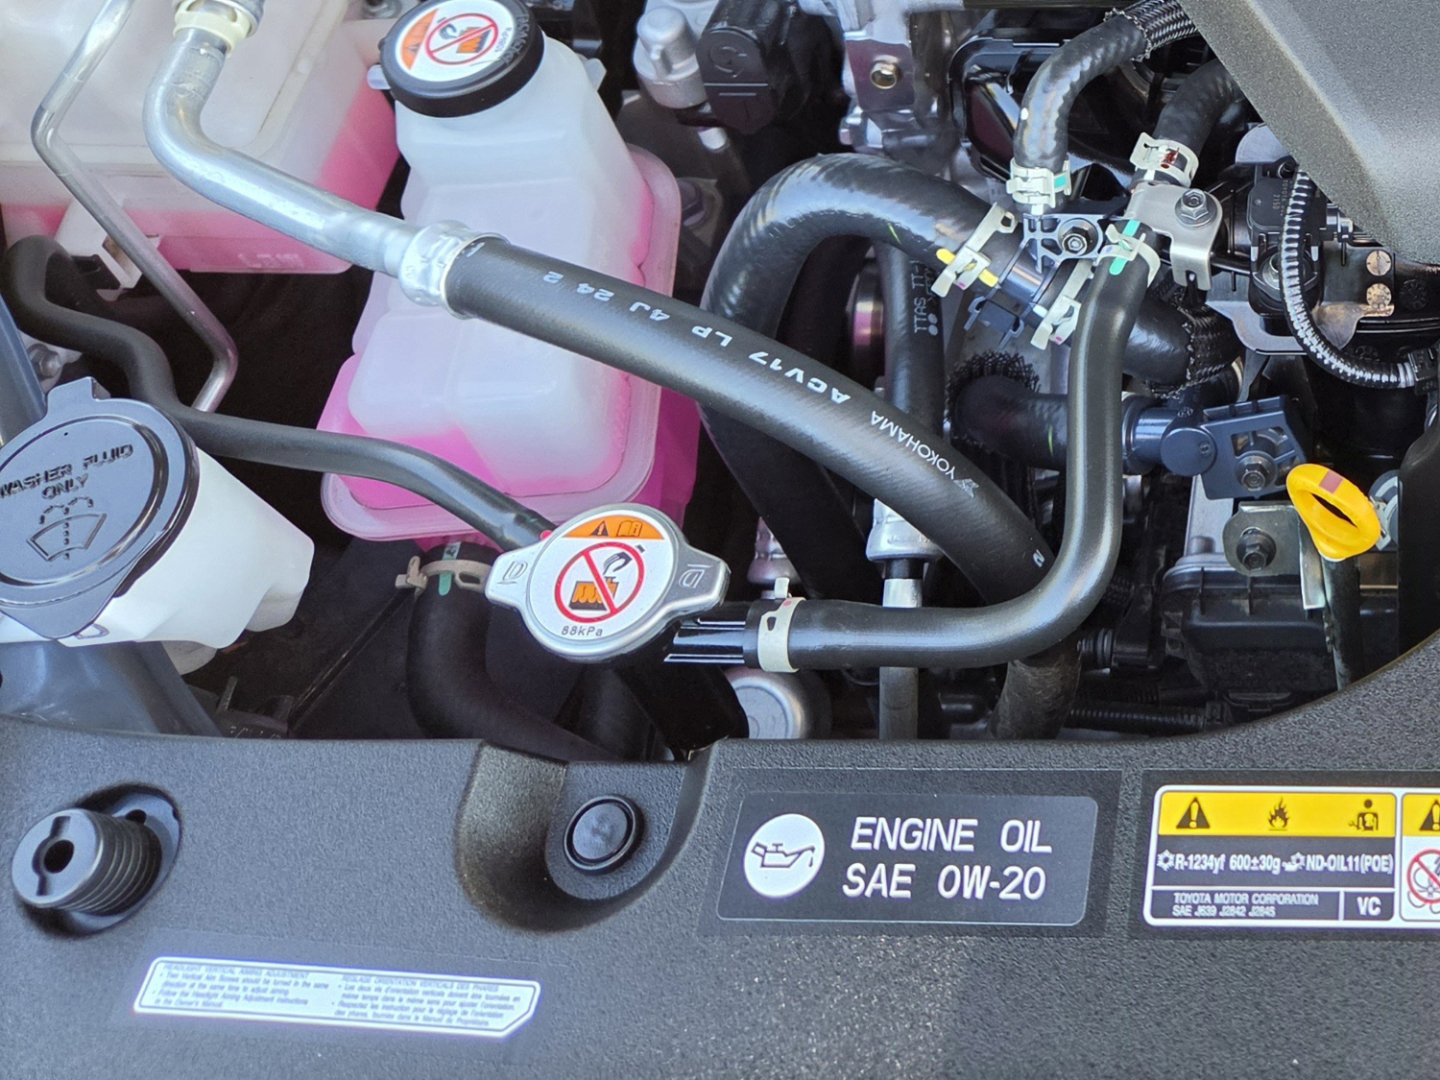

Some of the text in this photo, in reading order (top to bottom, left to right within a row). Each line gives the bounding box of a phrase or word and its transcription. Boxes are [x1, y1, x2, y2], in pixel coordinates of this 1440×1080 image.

[542, 270, 957, 480] YOKOHAMA ACV17 LP 4J 24 2
[82, 444, 134, 470] FLUID
[42, 472, 89, 499] ONLY
[560, 624, 603, 637] 88kPa
[850, 816, 1053, 854] ENGINE OIL
[1174, 853, 1394, 875] R-1234yf 600±30g ND-OIL11(POE)
[842, 862, 1046, 900] SAE 0W-20
[1172, 905, 1193, 916] SAE
[1173, 892, 1319, 906] TOYOTA MOTOR CORPORATION
[1357, 896, 1382, 916] VC
